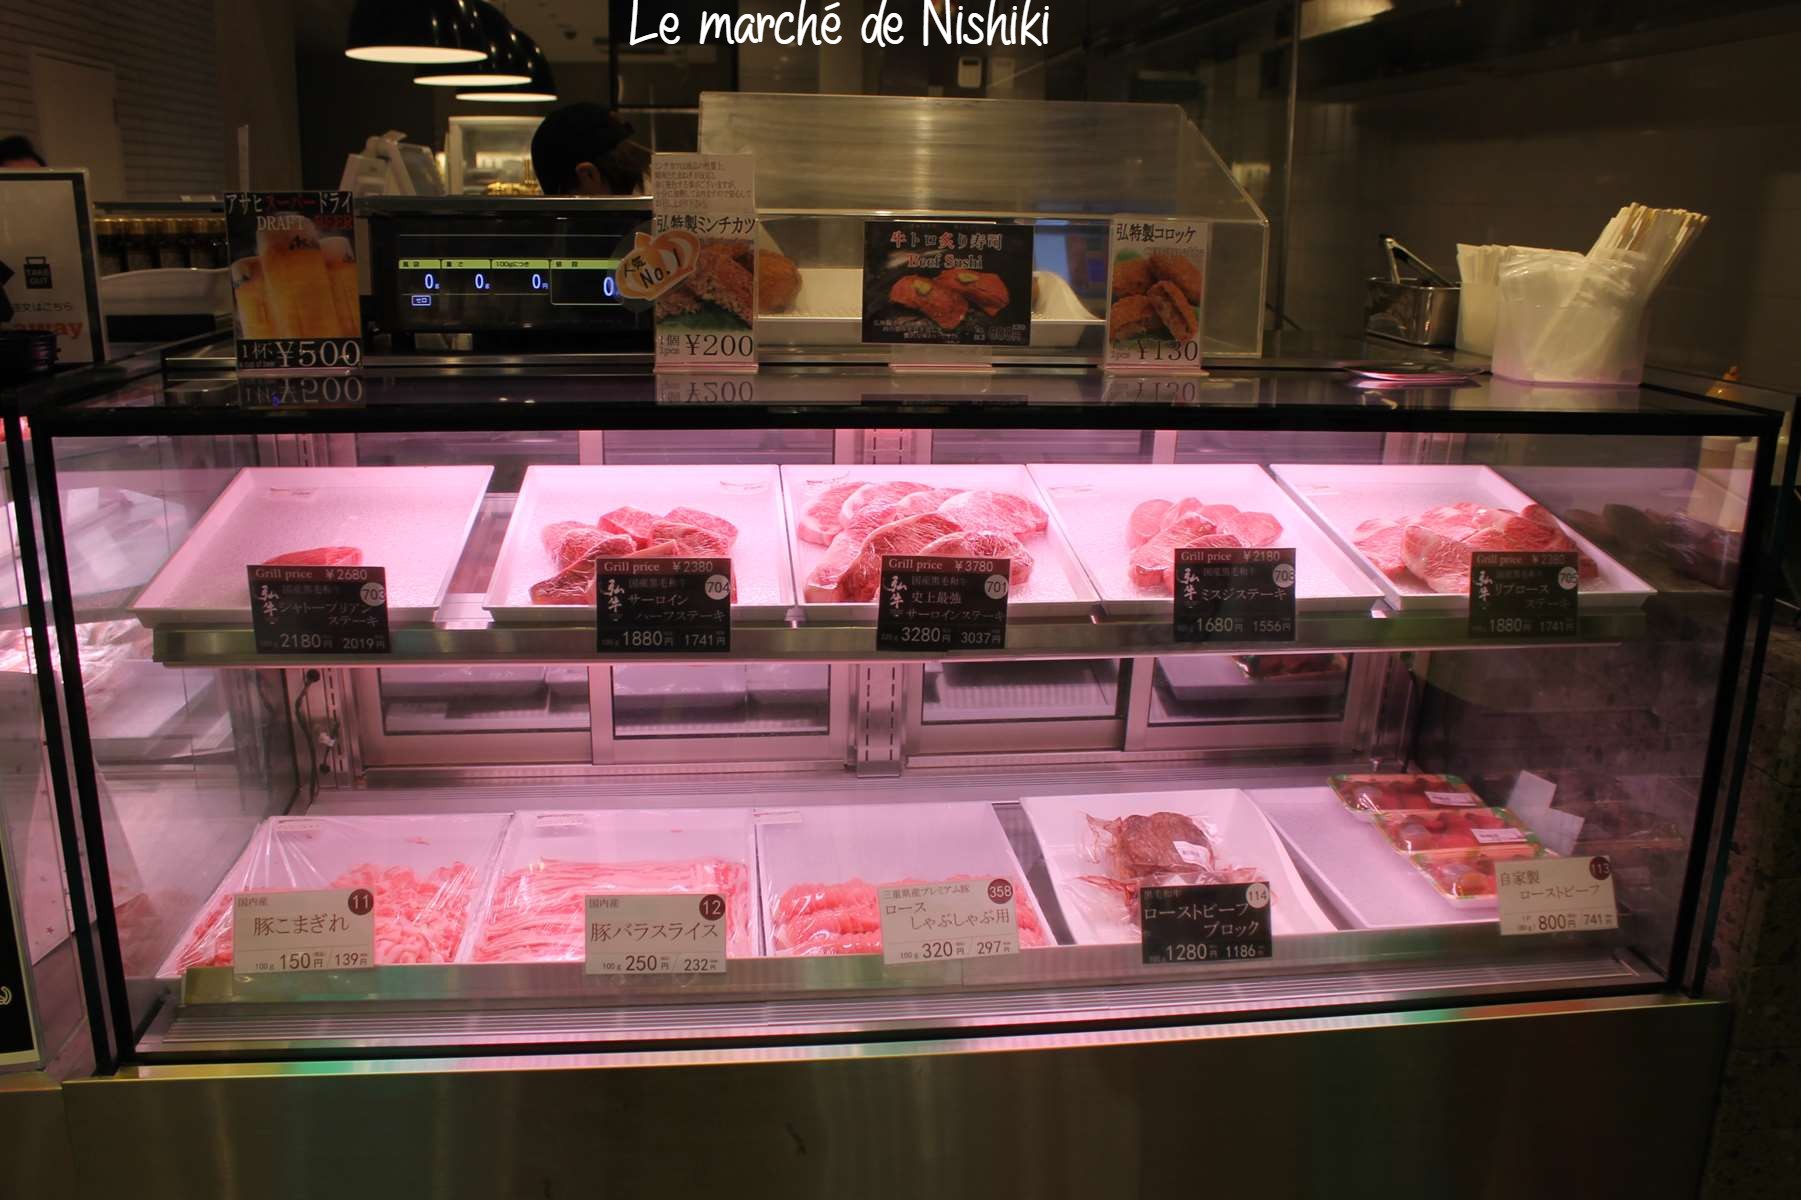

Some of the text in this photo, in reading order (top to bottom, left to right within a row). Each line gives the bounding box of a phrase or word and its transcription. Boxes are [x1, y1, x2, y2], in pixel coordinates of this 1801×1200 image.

[257, 216, 305, 231] DRAFT
[1116, 223, 1197, 243] 弘特製コロッケ
[889, 230, 1003, 251] 牛トロ炙り寿司
[907, 253, 984, 269] Beef Sushi
[640, 268, 670, 289] No.
[685, 334, 754, 357] ¥200
[1136, 340, 1198, 361] ¥130
[275, 340, 361, 368] ¥500
[1181, 550, 1280, 564] Grill price ¥2180
[604, 561, 713, 575] Grill price ¥2380
[888, 559, 993, 572] Grill price ¥3780
[255, 568, 368, 581] Grill price ¥2680
[363, 588, 385, 600] 703
[706, 581, 730, 593] 704
[987, 581, 1007, 593] 701
[1495, 583, 1551, 596] リブロース
[628, 594, 689, 606] サーロイン
[912, 591, 962, 605] 史上最強
[1200, 588, 1287, 601] ミスジステーキ
[280, 601, 370, 615] シャトーブリアン
[328, 616, 379, 628] ステーキ
[635, 610, 726, 622] ハーフステーキ
[905, 610, 1003, 622] サーロインステーキ
[1591, 863, 1610, 875] 113
[1500, 870, 1540, 886] 自家製
[988, 885, 1012, 898] 358
[1520, 884, 1600, 900] ローストビーフ
[237, 897, 268, 907] 国内産
[353, 894, 369, 909] 11
[589, 898, 619, 909] 国内産
[703, 899, 721, 915] 12
[886, 902, 927, 915] ロース
[1144, 902, 1249, 921] ローストビーフ
[253, 913, 350, 936] 豚こまぎれ
[911, 908, 1009, 930] しゃぶしゃぶ用
[591, 921, 719, 942] 豚バラスライス
[1203, 920, 1259, 938] ブロック
